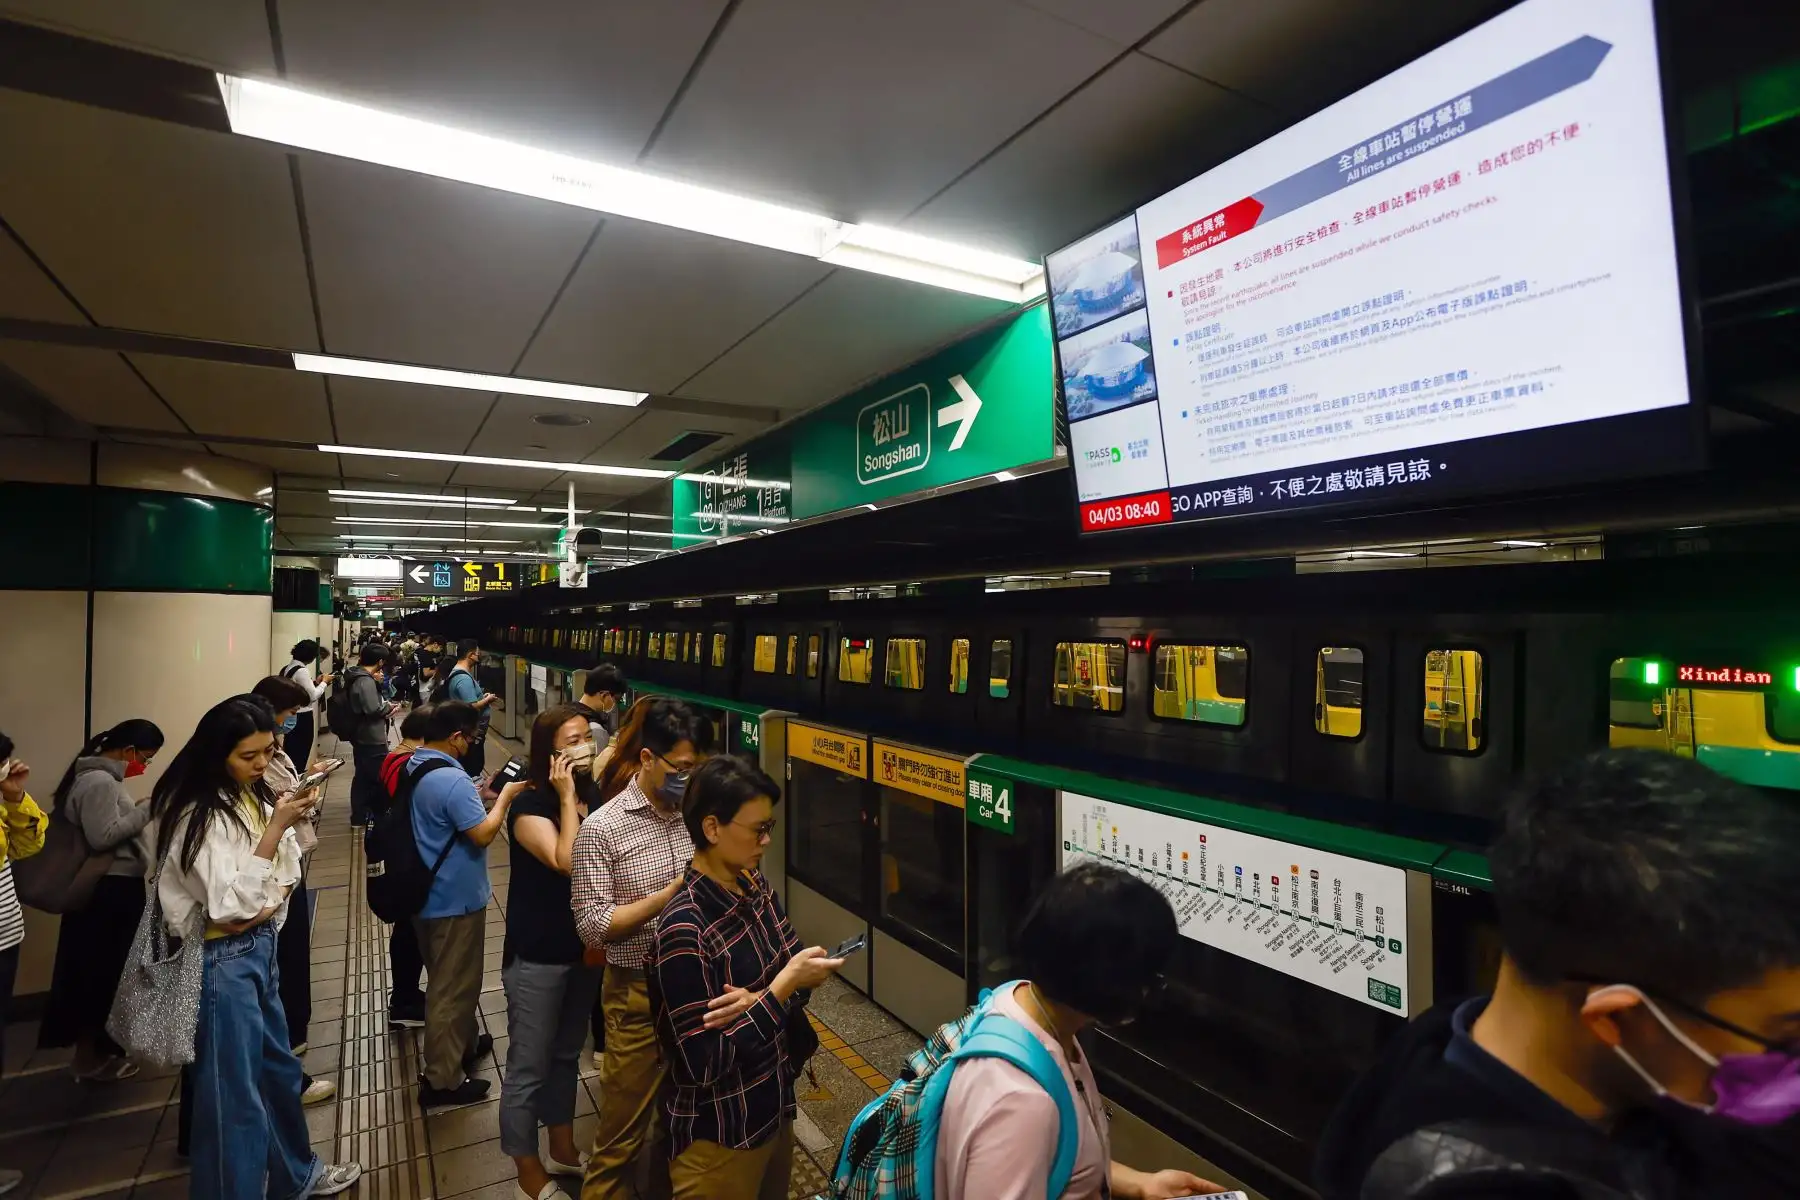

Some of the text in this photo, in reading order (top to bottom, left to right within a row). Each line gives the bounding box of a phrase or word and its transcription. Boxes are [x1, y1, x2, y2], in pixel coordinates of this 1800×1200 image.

[1337, 94, 1472, 173] 全線車站暫停營運
[1346, 119, 1466, 182] All lines are suspended
[1180, 211, 1225, 244] 系統異常
[1182, 229, 1227, 257] System Fault
[873, 403, 909, 446] 松山
[865, 442, 920, 472] Songshan
[705, 482, 711, 500] G
[1089, 501, 1159, 524] 04/03 08:40
[494, 562, 504, 580] 1
[1680, 667, 1771, 683] Xindian
[752, 724, 759, 746] 4
[969, 780, 992, 803] 車廂
[980, 806, 993, 818] Car
[995, 789, 1011, 823] 4
[1253, 881, 1260, 898] 北門
[1272, 887, 1279, 902] 中山
[1311, 880, 1319, 914] 南京復興
[1452, 885, 1471, 895] 141L
[1376, 915, 1384, 933] 松山
